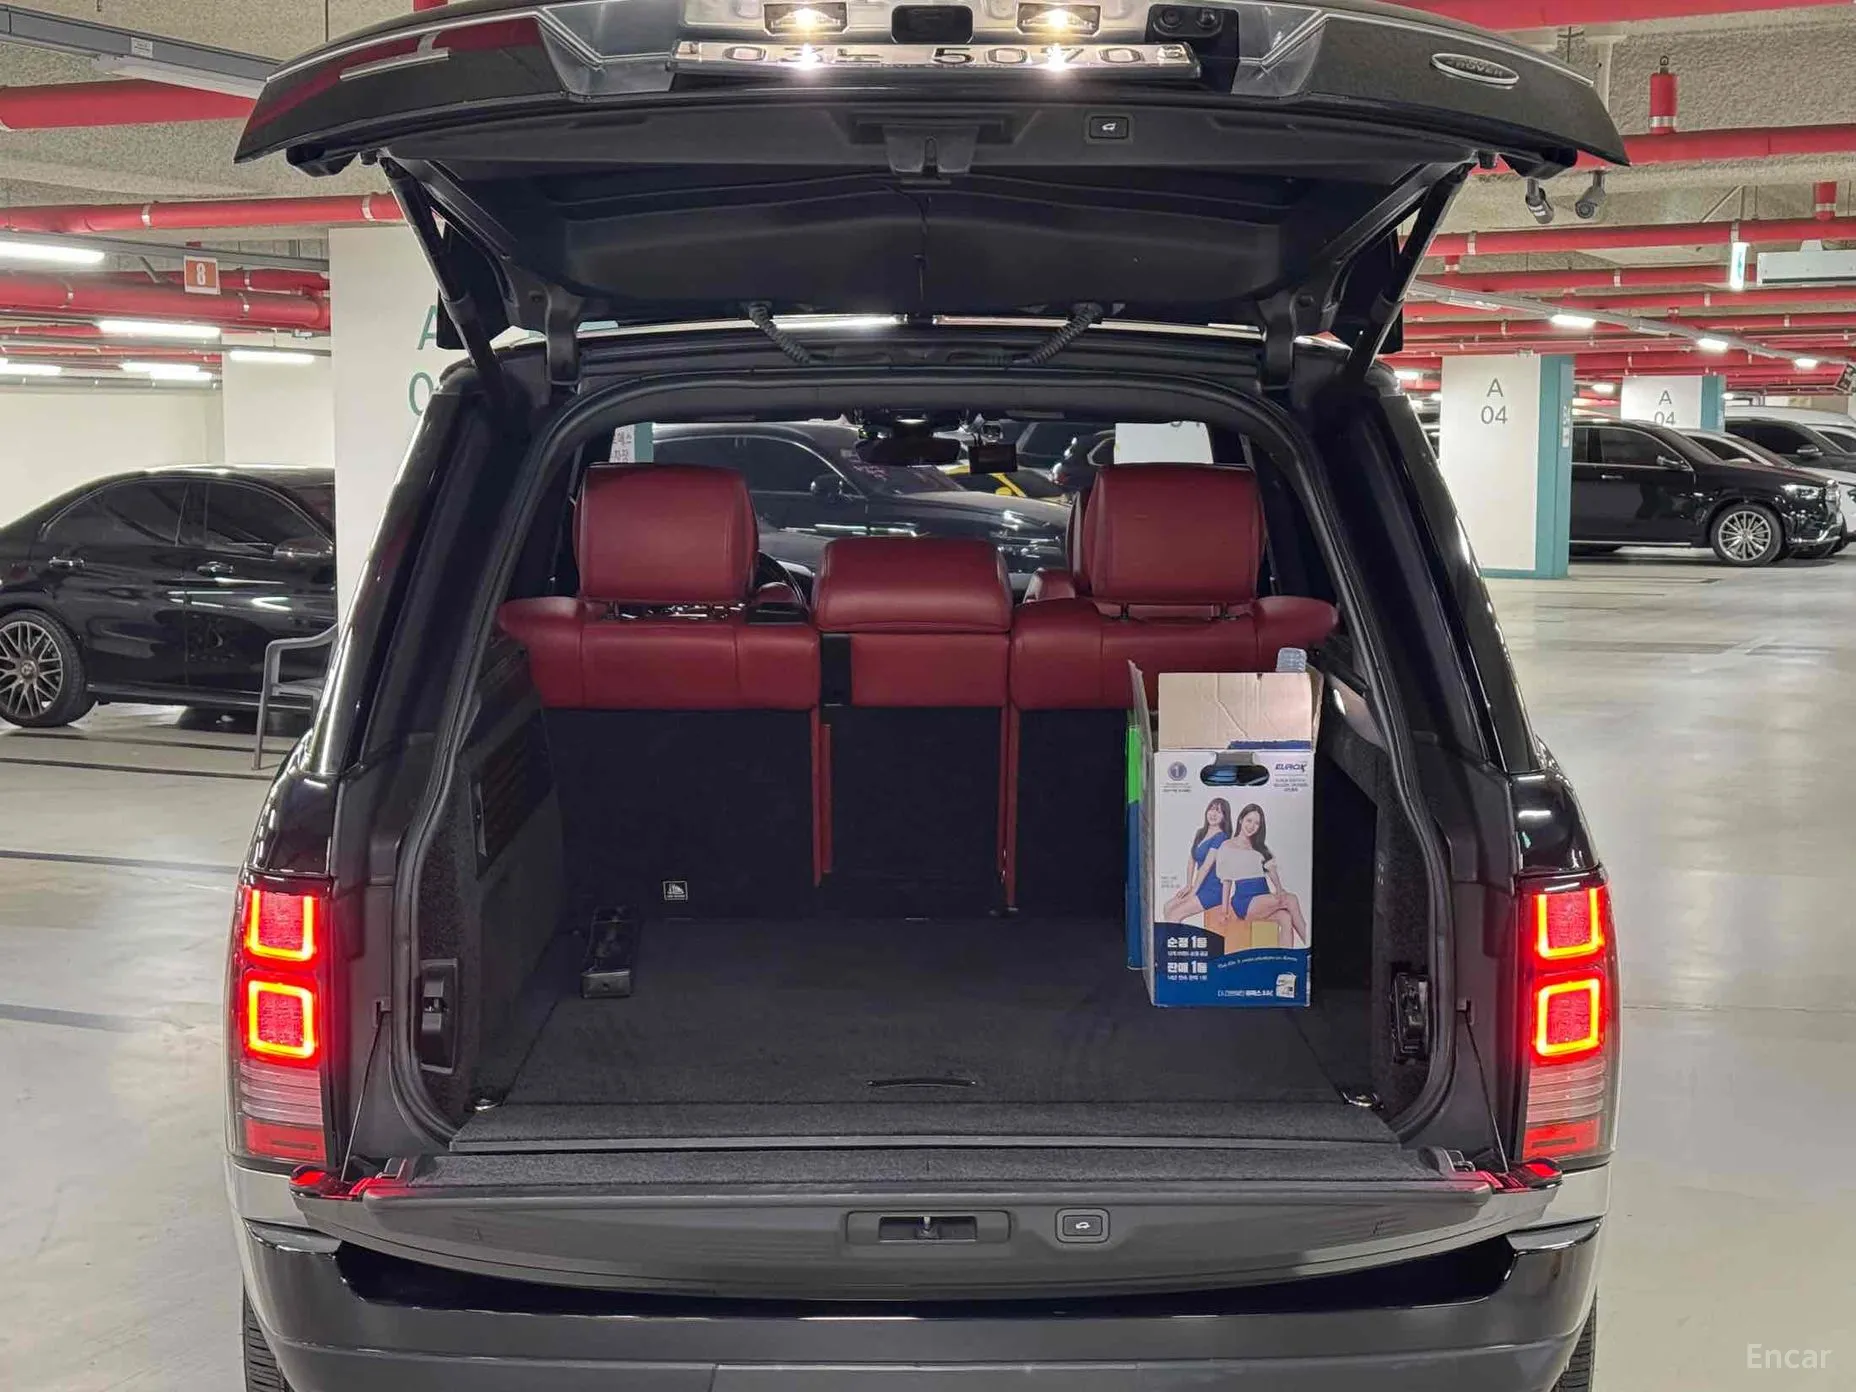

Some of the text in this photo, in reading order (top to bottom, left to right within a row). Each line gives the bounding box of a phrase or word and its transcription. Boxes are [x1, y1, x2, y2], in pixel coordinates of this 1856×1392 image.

[196, 262, 206, 286] 8
[1486, 378, 1504, 398] A
[1658, 389, 1673, 406] A
[1481, 404, 1508, 425] 04
[1653, 411, 1676, 426] 04
